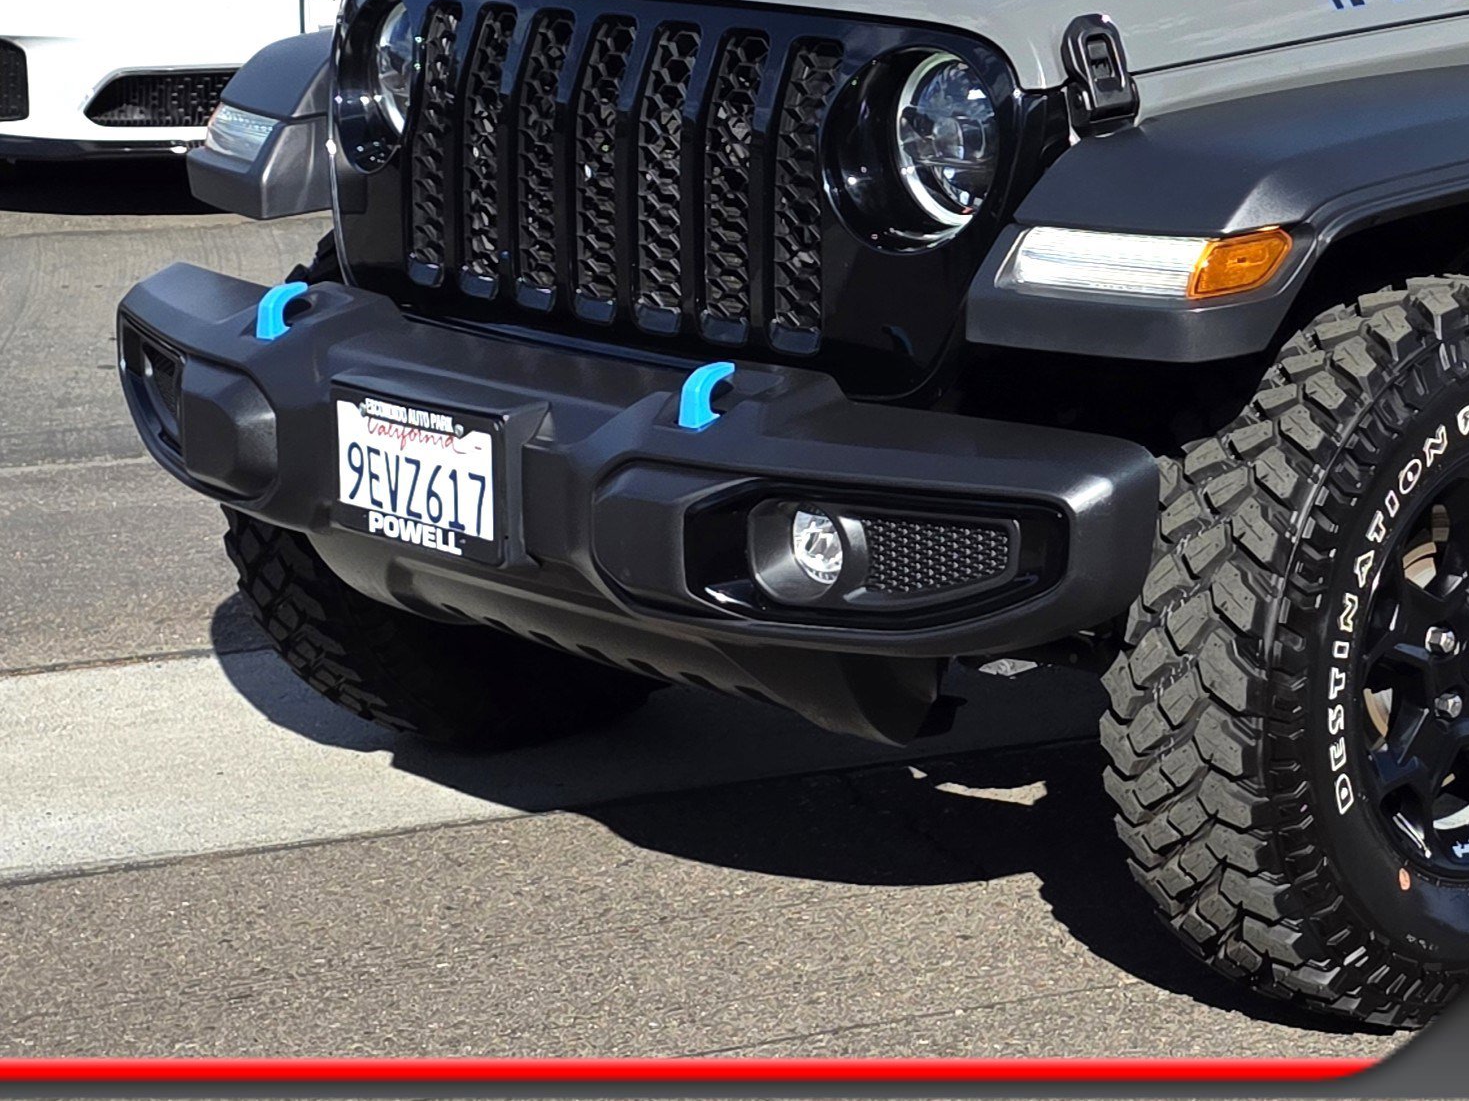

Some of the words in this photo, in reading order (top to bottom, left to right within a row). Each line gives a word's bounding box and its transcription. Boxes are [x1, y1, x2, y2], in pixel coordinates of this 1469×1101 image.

[408, 408, 430, 429] AUTO
[430, 412, 454, 433] PARK
[347, 441, 486, 537] 9EVZ617
[368, 510, 463, 556] POWELL
[1328, 425, 1450, 816] DESTINATION
